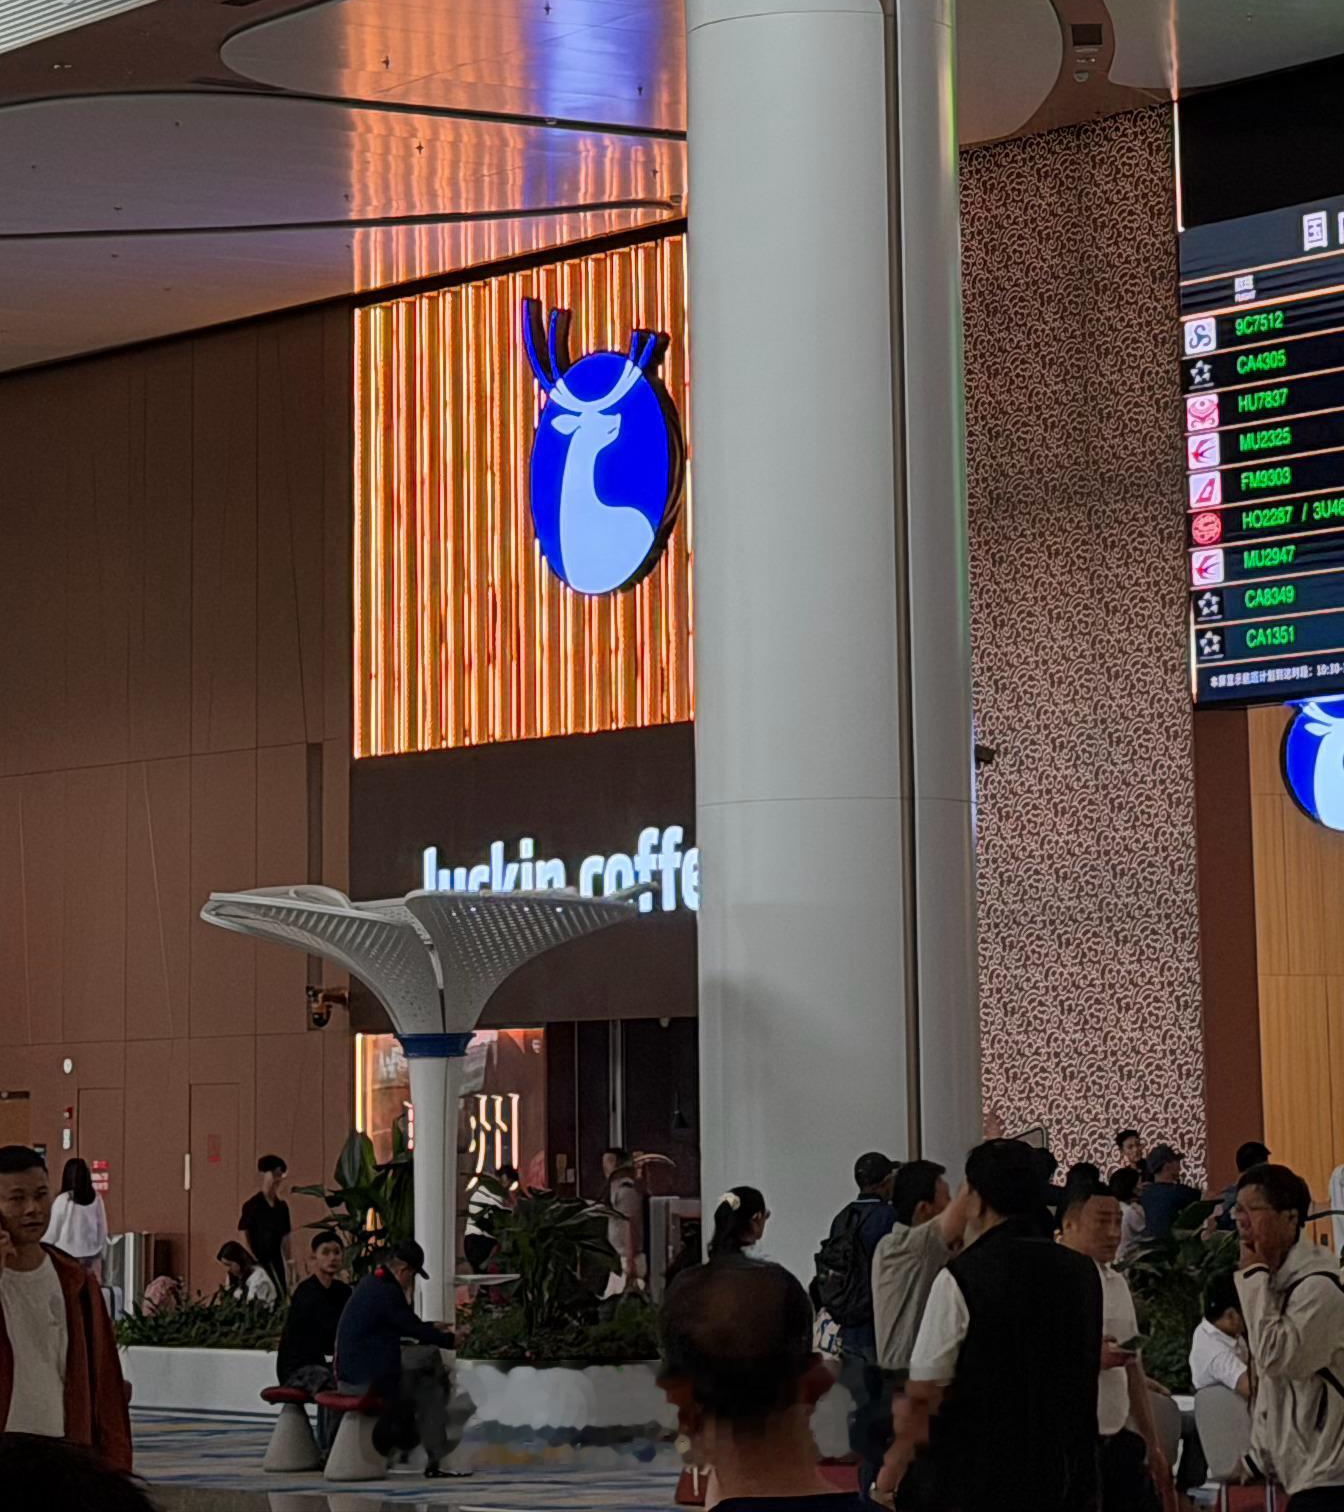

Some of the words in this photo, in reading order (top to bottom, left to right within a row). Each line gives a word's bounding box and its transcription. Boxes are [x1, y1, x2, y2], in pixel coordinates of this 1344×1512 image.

[1235, 311, 1285, 336] 9C7512
[1236, 349, 1287, 374] CA4305
[1237, 387, 1289, 412] HU7837
[1239, 426, 1292, 451] MU2325
[1240, 466, 1292, 490] FM9303
[1243, 545, 1297, 568] MU2947
[1245, 624, 1295, 648] CA1351
